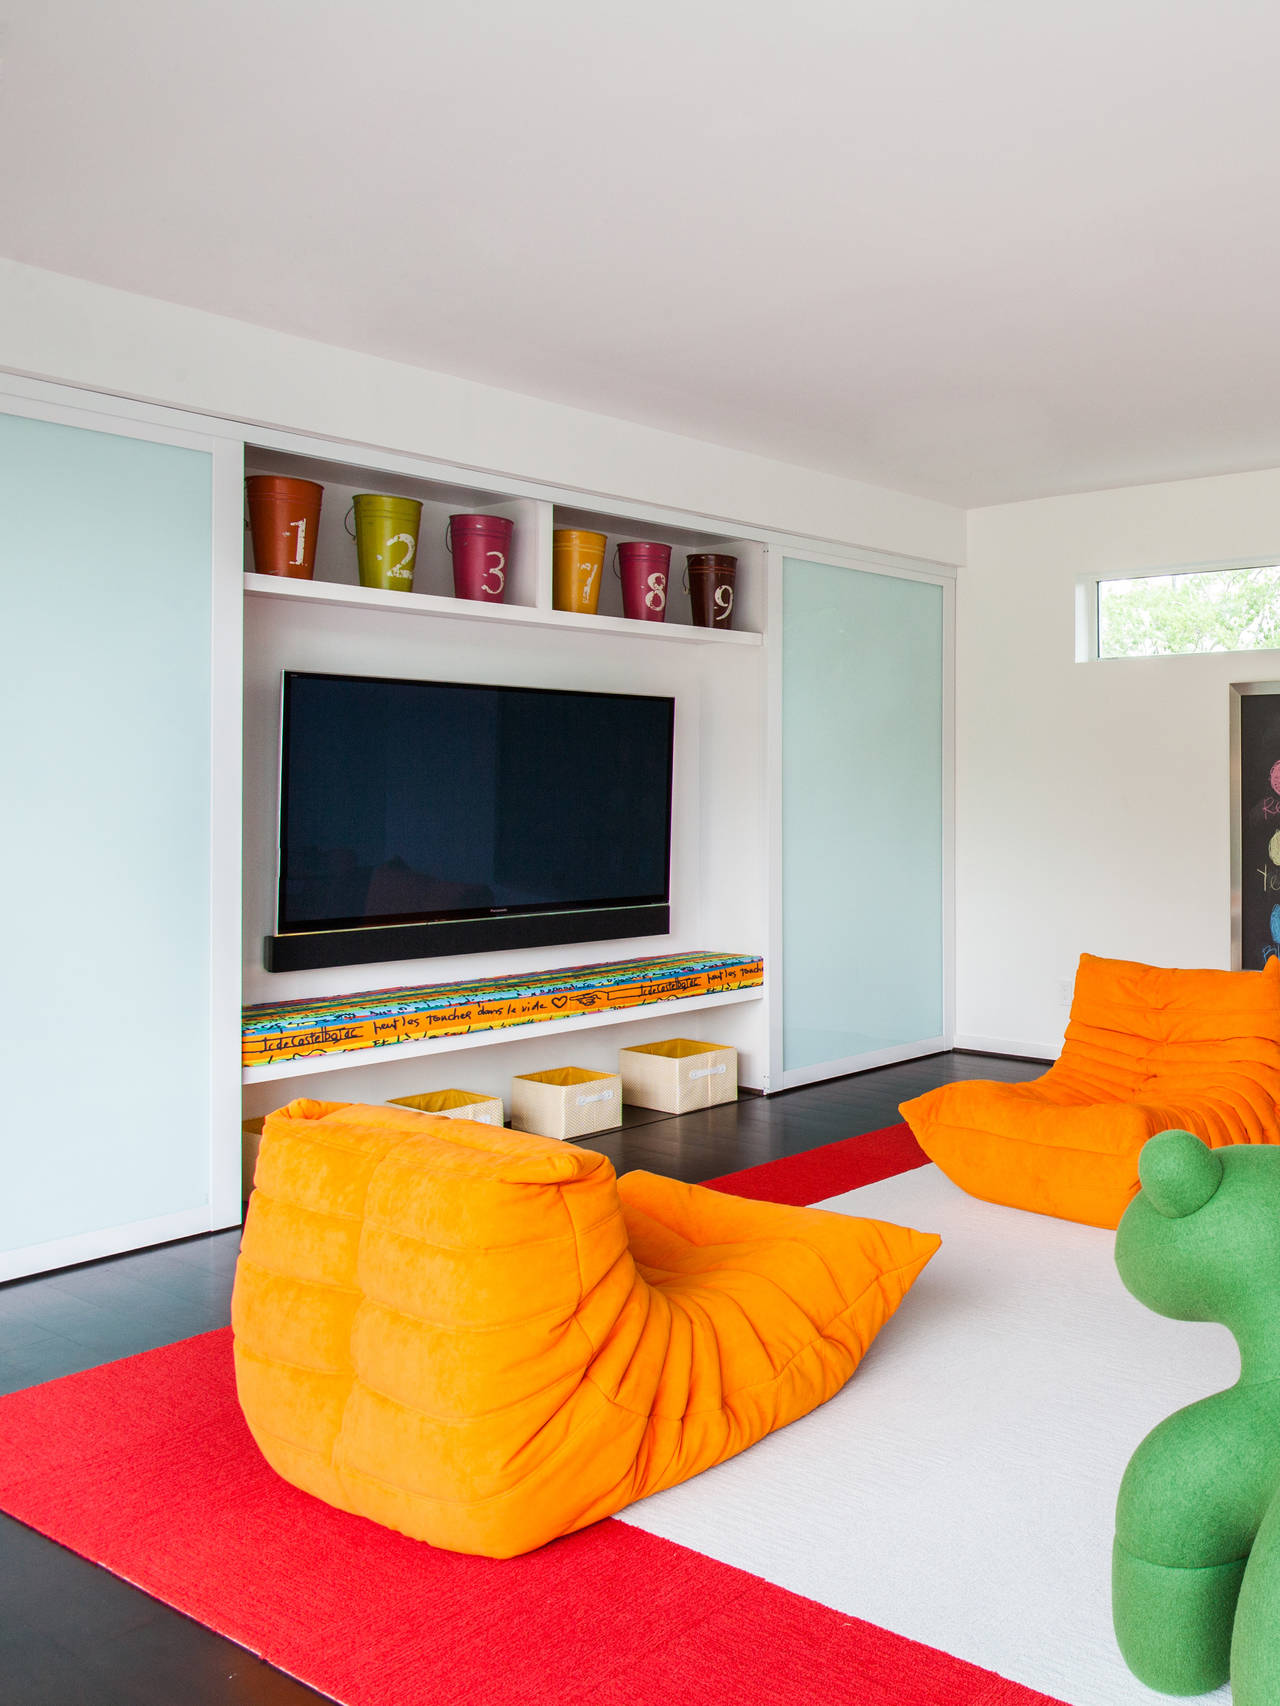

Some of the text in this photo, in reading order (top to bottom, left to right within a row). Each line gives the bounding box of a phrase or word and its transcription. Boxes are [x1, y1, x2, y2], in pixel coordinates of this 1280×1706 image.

[288, 519, 307, 567] 1
[386, 533, 415, 580] 2
[480, 551, 506, 595] 3
[577, 562, 598, 604] 7
[645, 572, 667, 612] 8
[714, 585, 734, 621] 9
